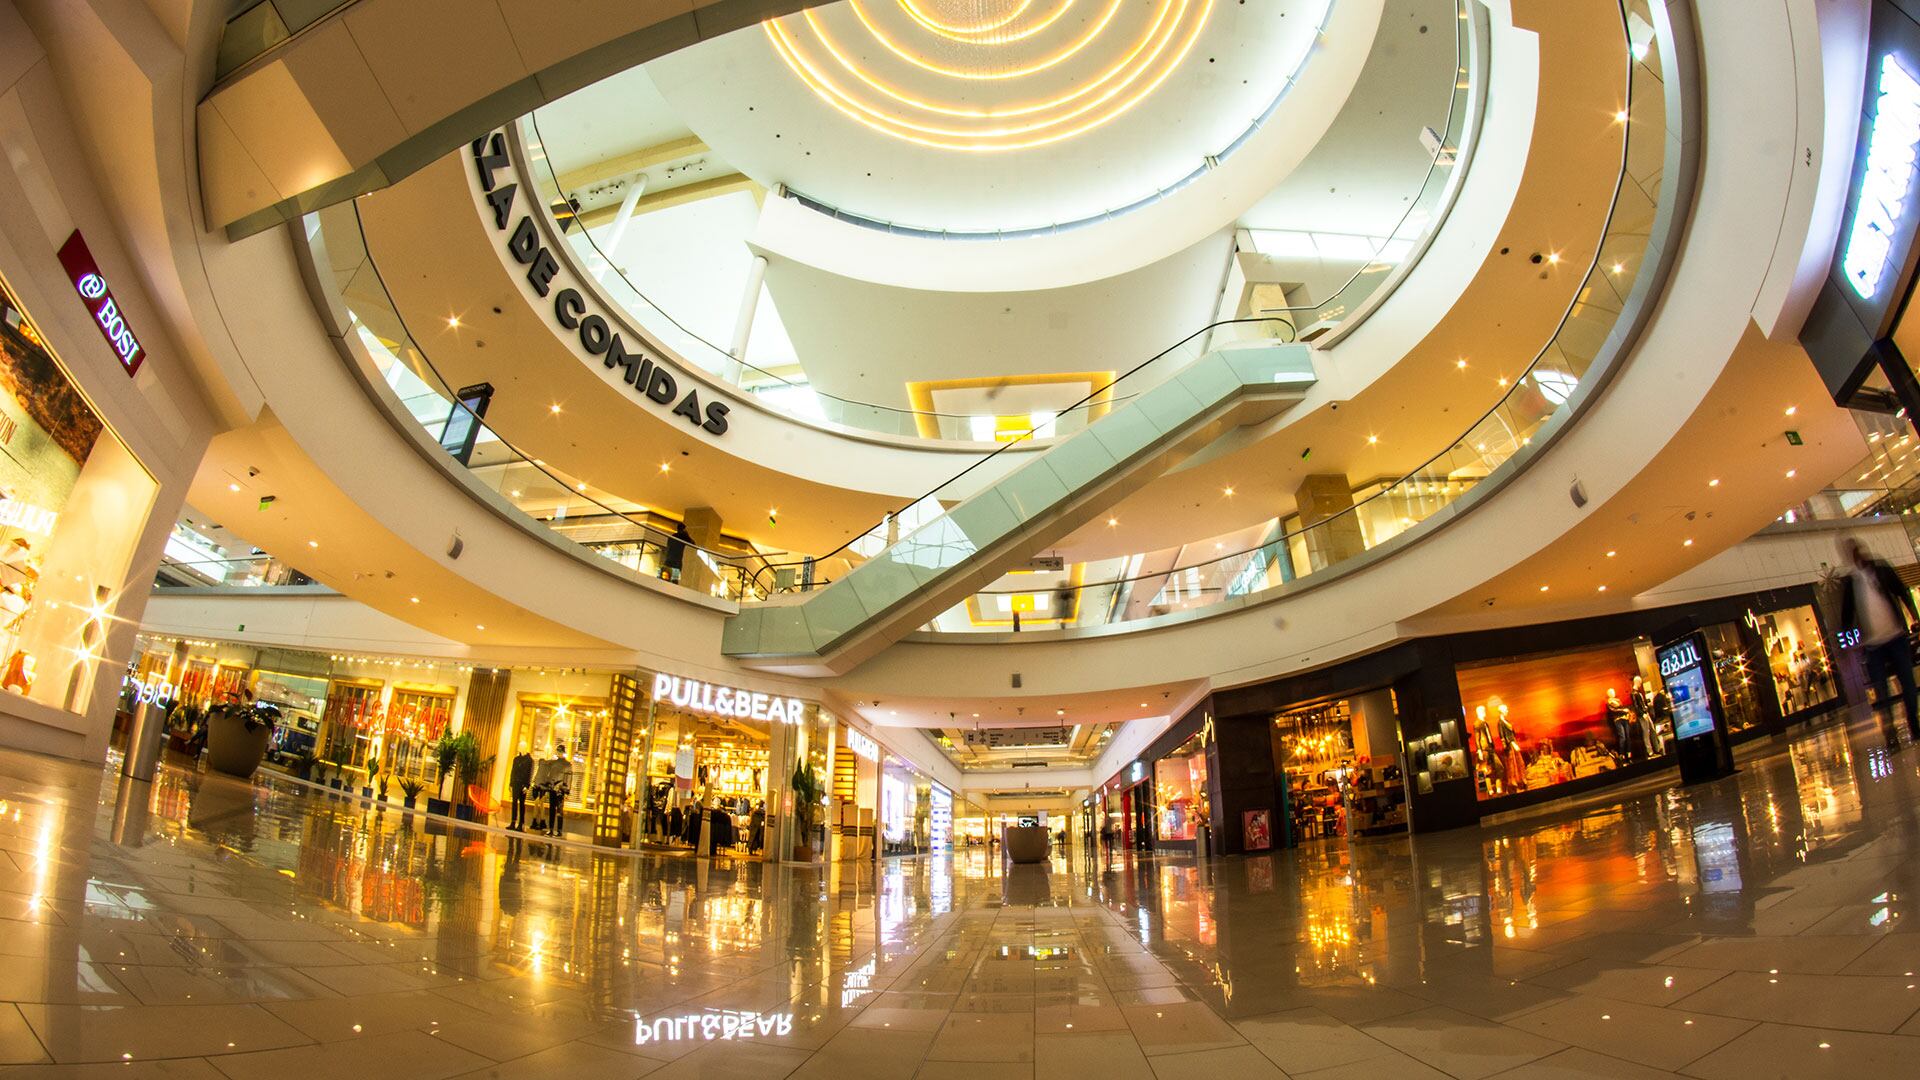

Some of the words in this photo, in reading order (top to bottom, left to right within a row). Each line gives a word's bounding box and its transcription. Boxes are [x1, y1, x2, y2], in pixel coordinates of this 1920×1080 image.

[96, 297, 139, 366] BOSI
[508, 216, 560, 297] DE
[555, 288, 731, 436] COMIDAS
[654, 673, 803, 725] PULL&BEAR
